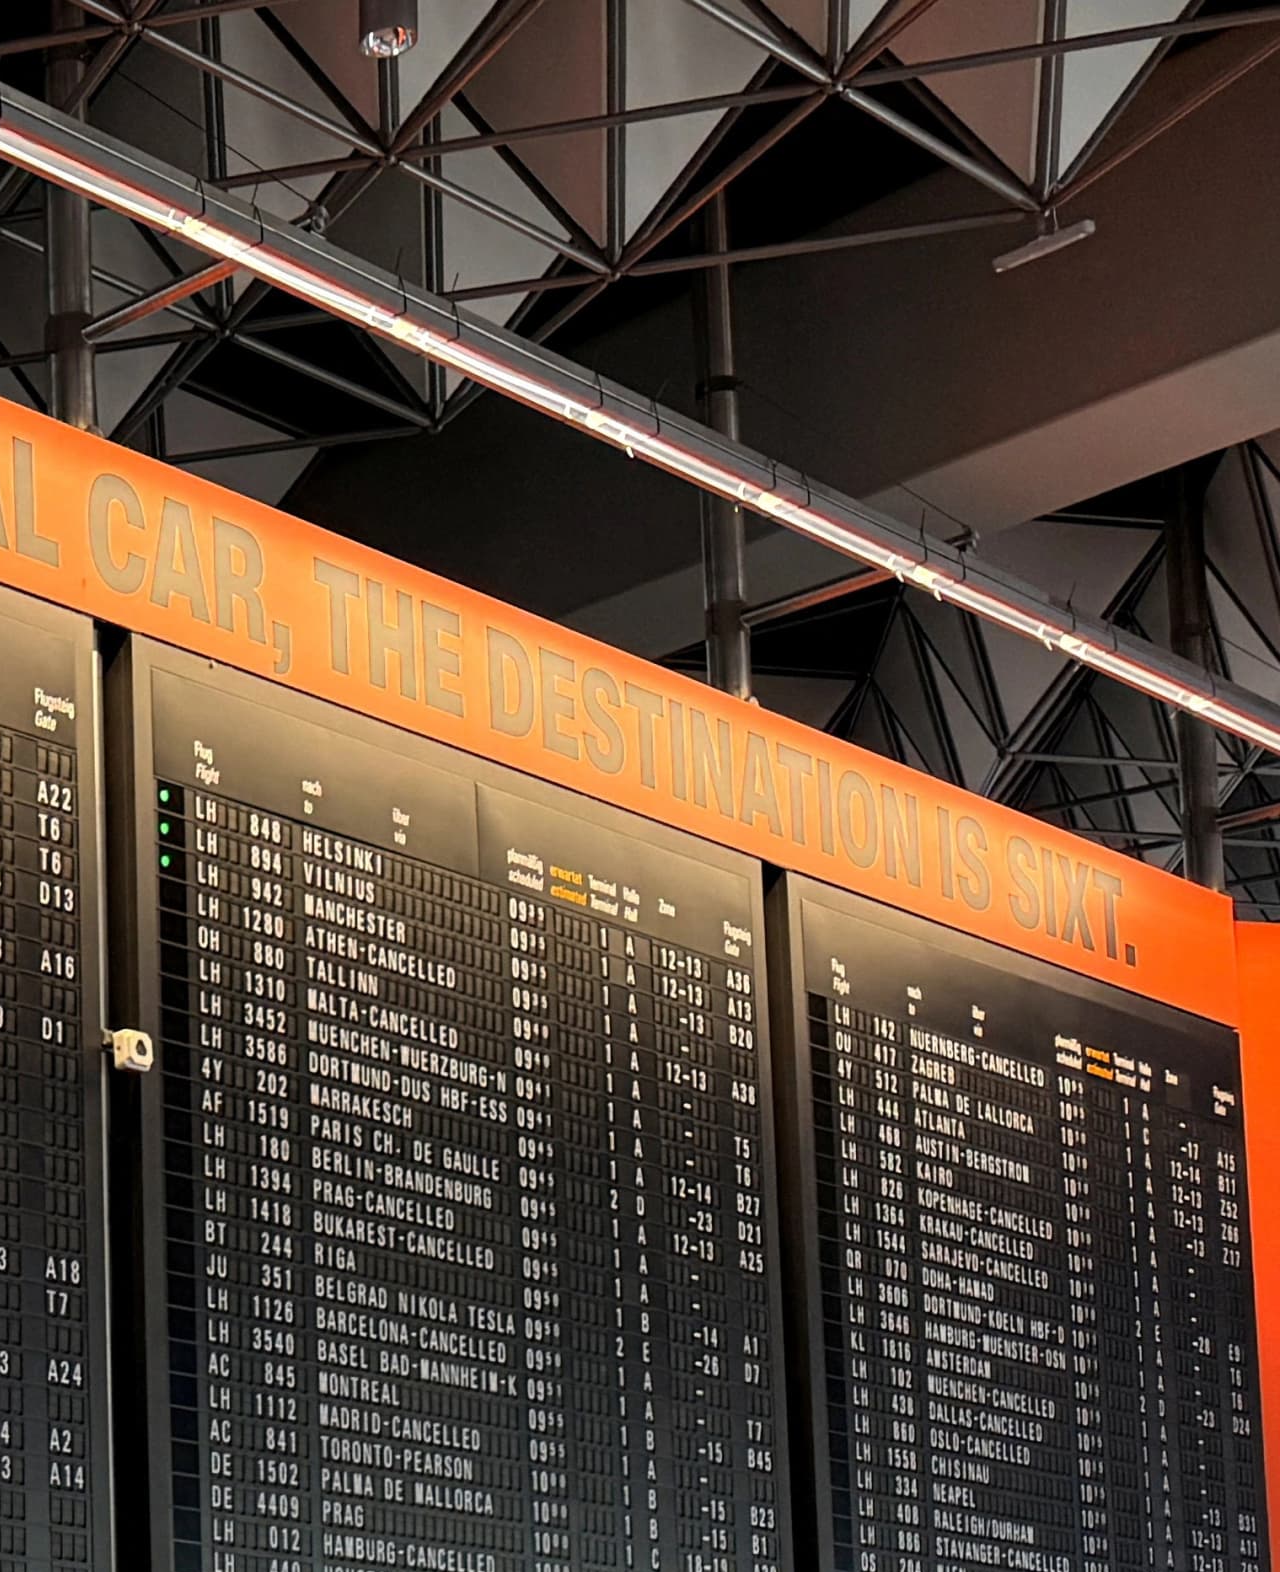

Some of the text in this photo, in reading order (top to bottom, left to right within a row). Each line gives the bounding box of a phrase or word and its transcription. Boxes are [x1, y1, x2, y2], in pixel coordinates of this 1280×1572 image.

[88, 472, 290, 676] CAR,
[314, 557, 463, 720] THE
[488, 625, 921, 889] DESTINATION
[938, 807, 990, 914] IS
[1008, 834, 1137, 968] SIXT.
[303, 827, 381, 875] HELSINKI
[304, 862, 374, 903] VILNIUS
[305, 894, 405, 943] MANCHESTER
[313, 1147, 491, 1208] BERLIN-BRANDENBURG
[315, 1243, 355, 1270] RIGA
[316, 1276, 514, 1333] BELGRAD NIKOLA TESLA
[320, 1372, 399, 1405] MONTREAL
